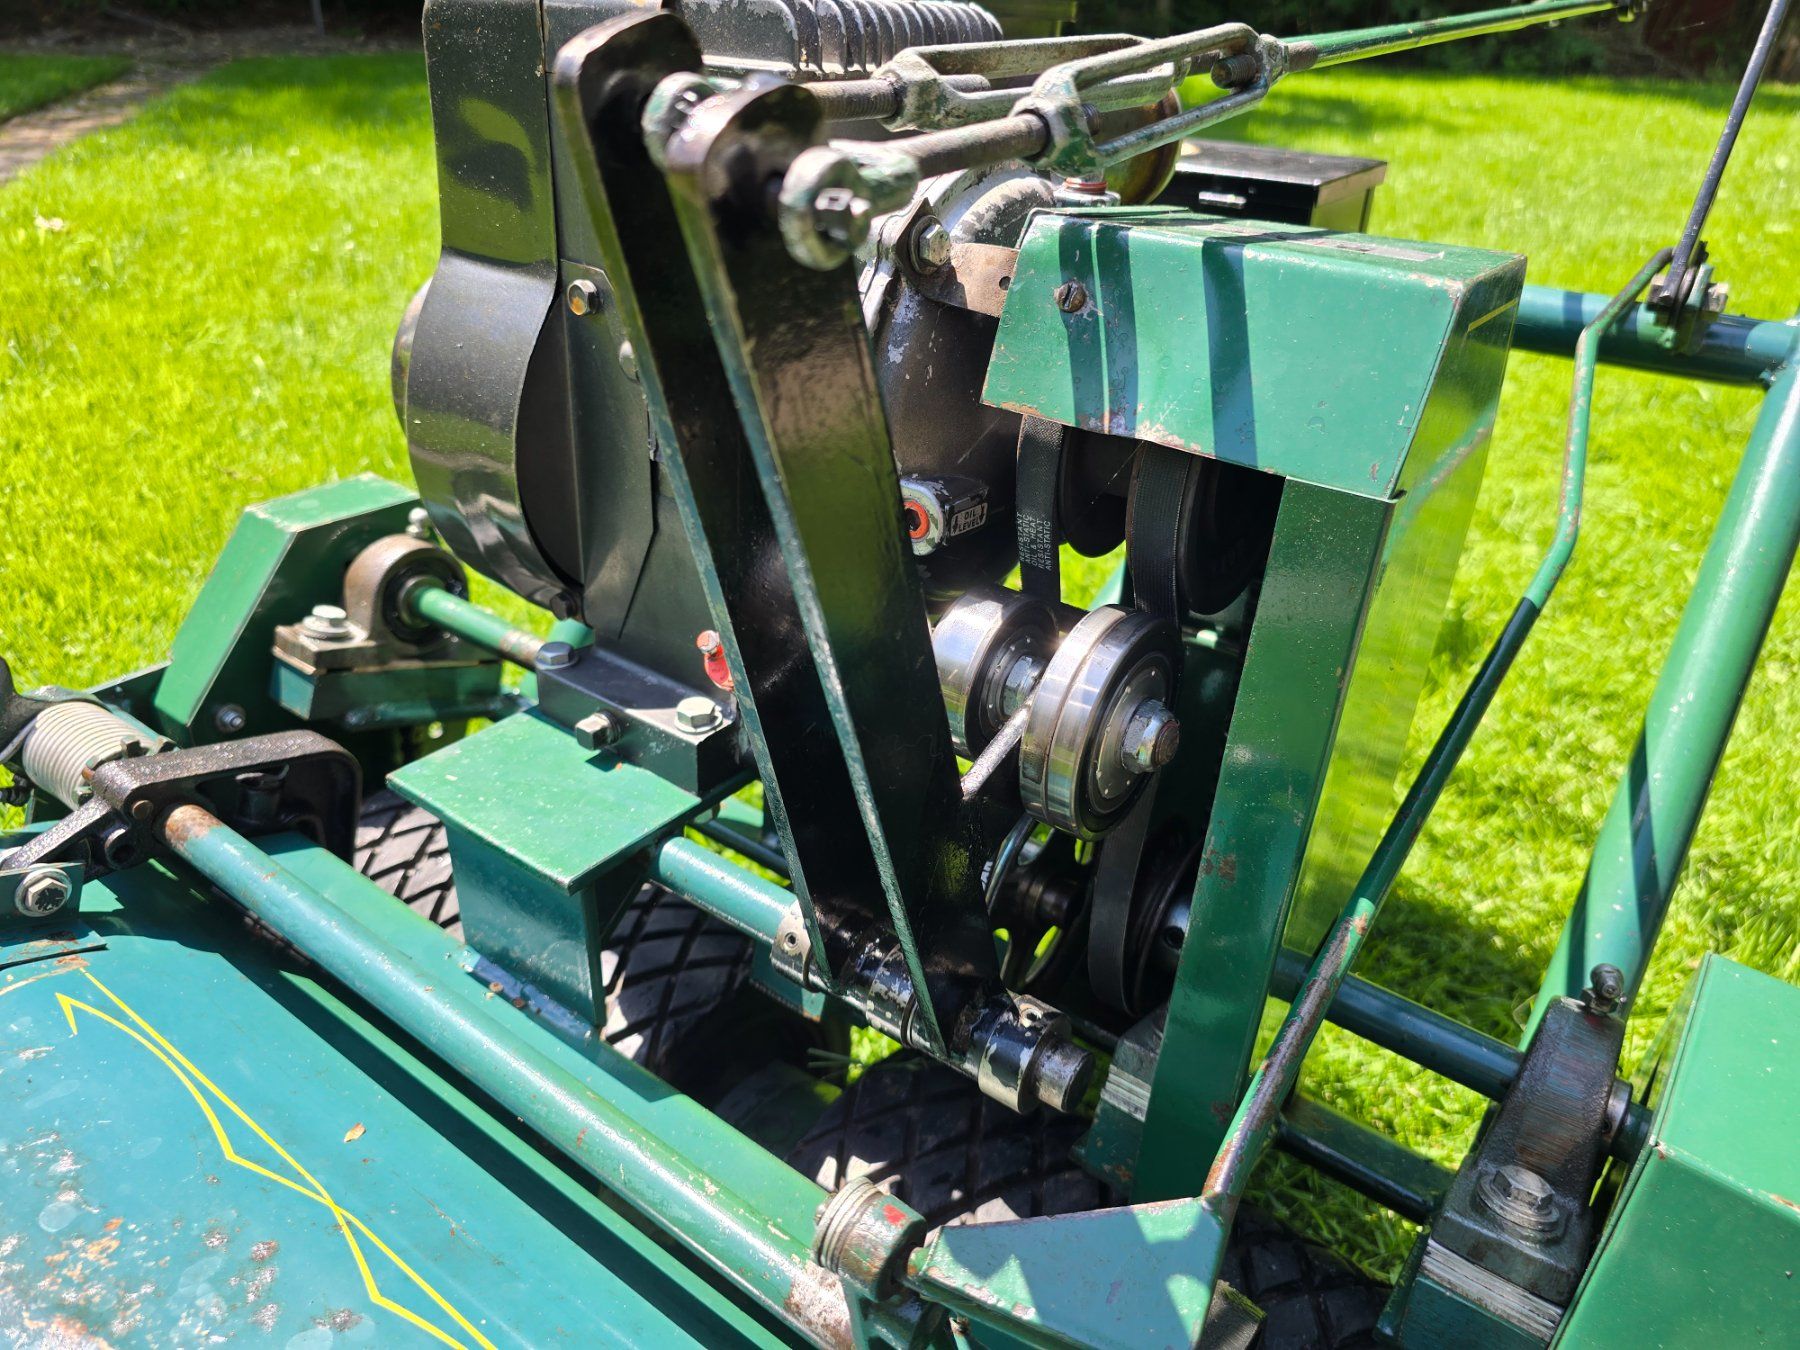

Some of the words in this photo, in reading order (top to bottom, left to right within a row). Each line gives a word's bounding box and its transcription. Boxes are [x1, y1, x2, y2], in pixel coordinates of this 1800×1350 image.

[959, 516, 980, 531] LEVEL
[964, 509, 976, 520] OIL
[1017, 512, 1025, 562] RESISTANT
[1023, 514, 1031, 564] ANTI-STATIC
